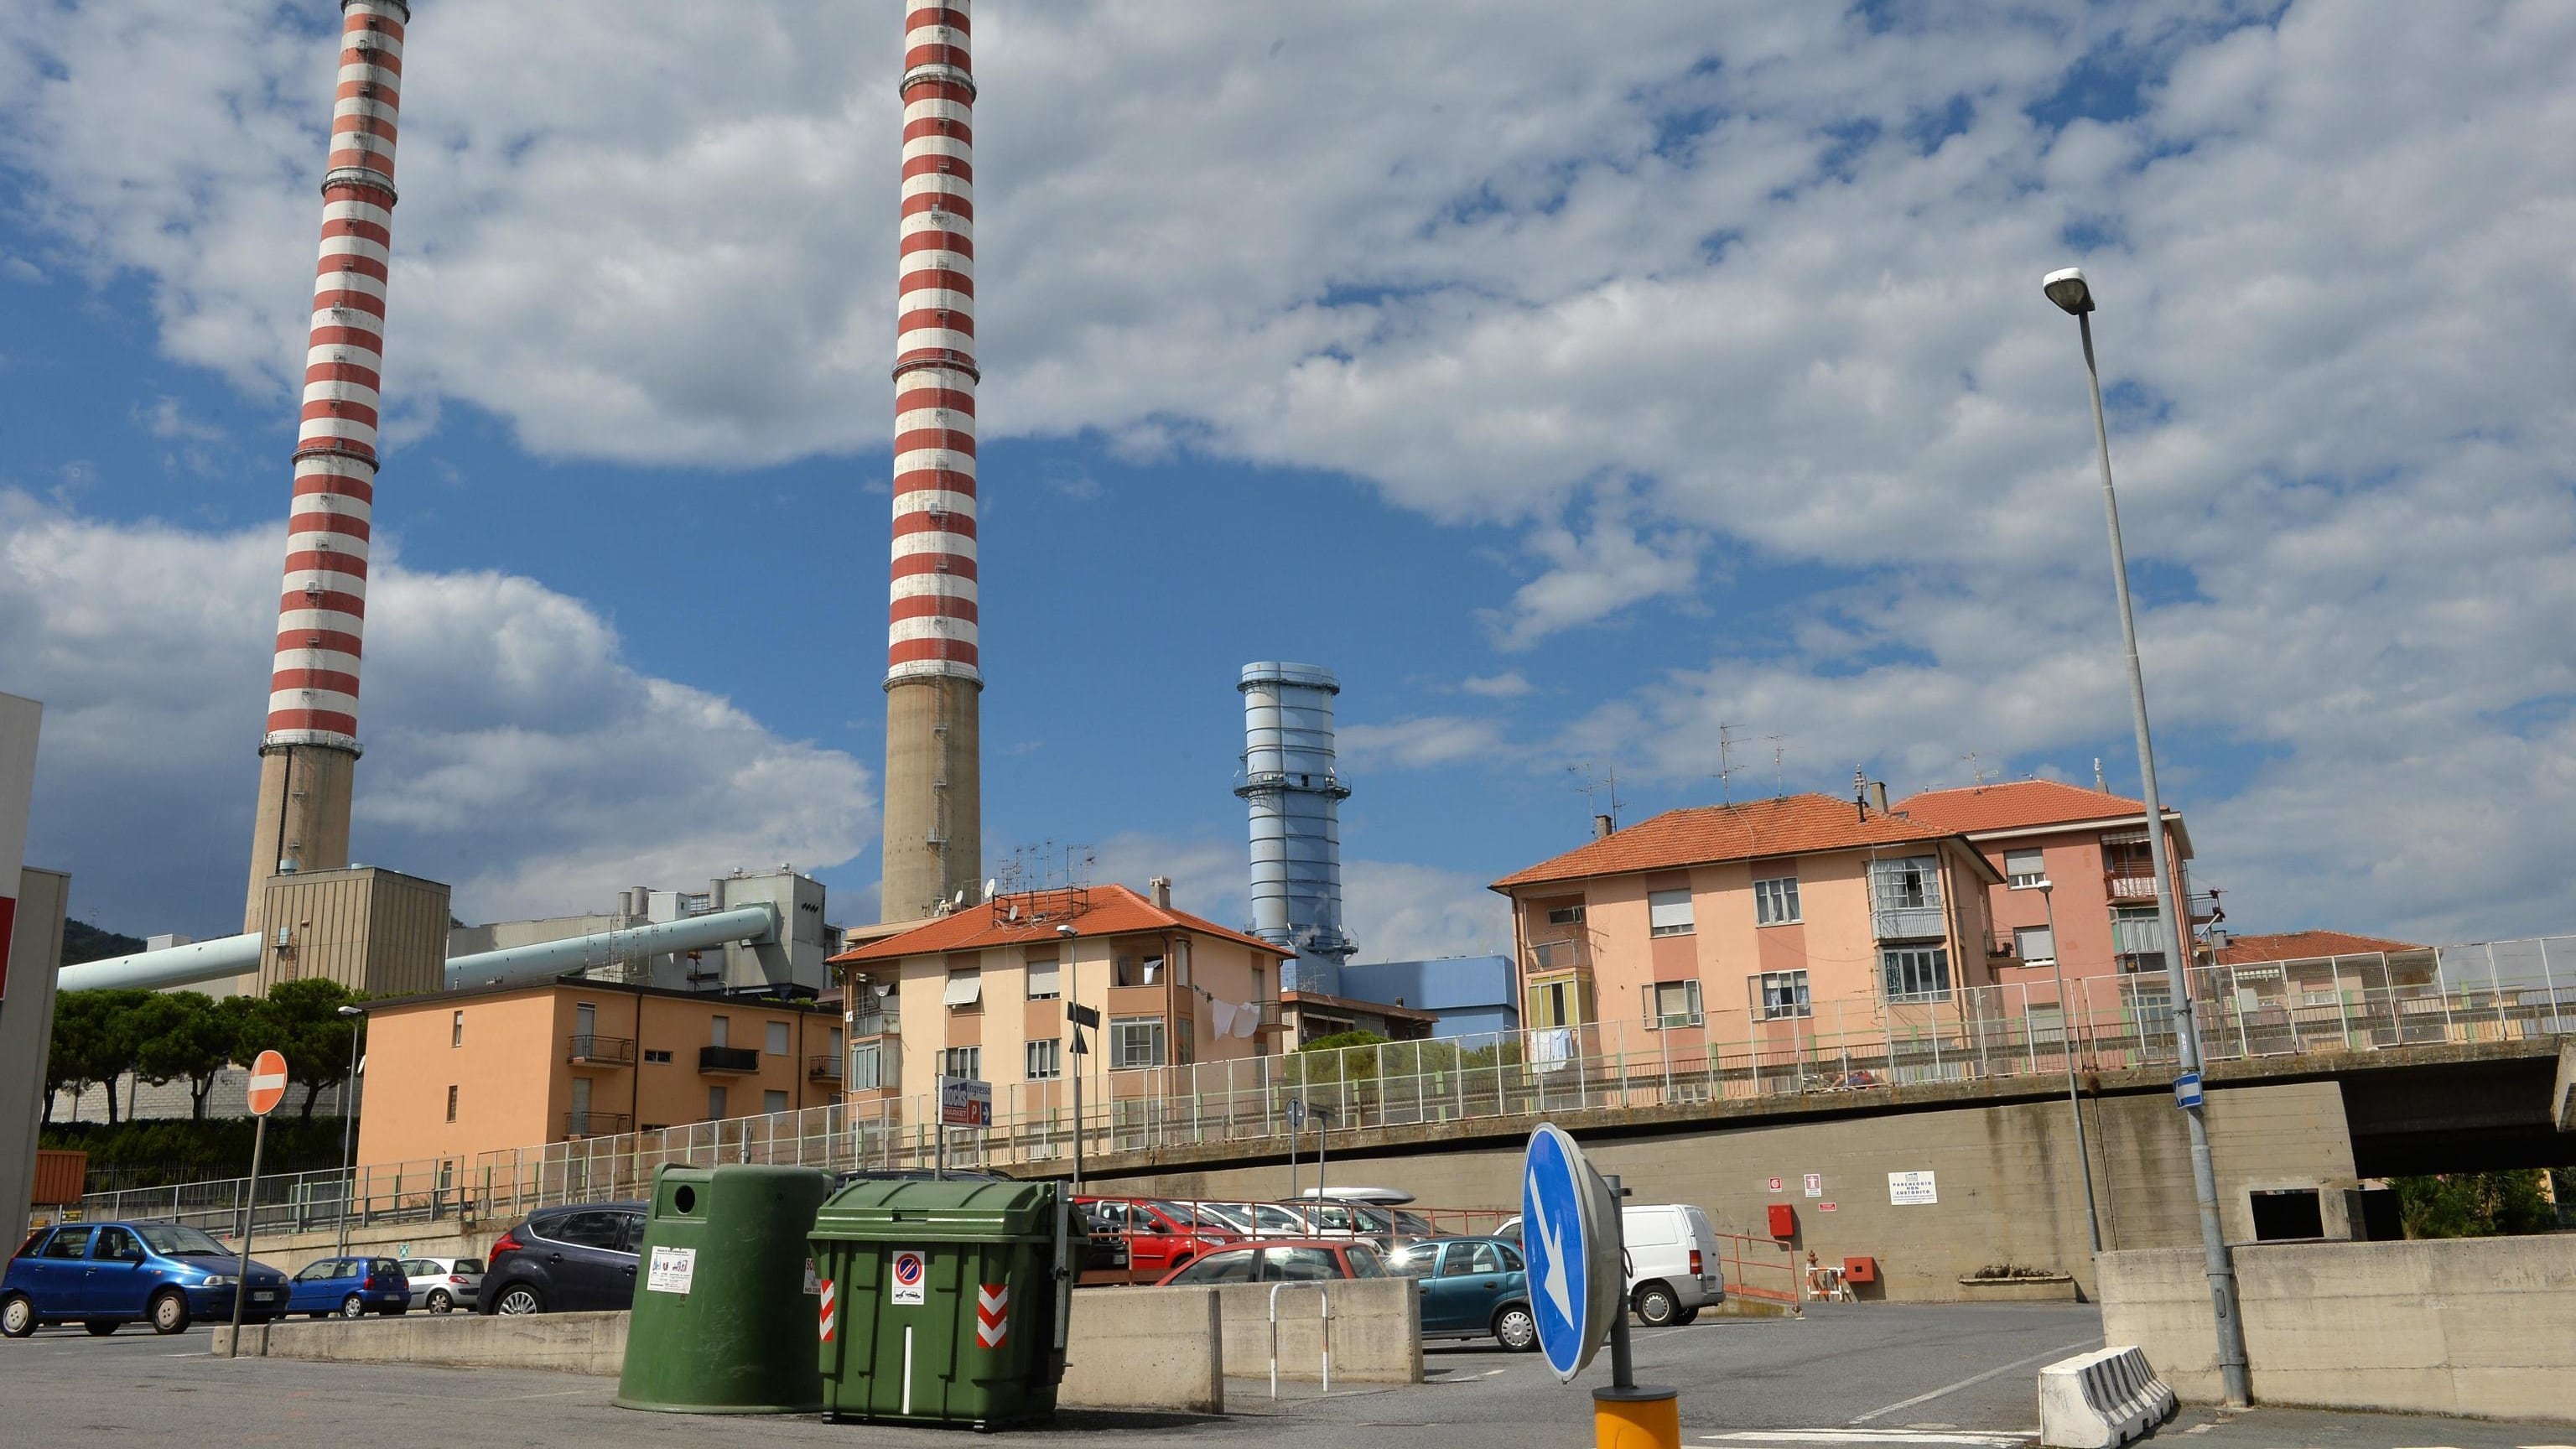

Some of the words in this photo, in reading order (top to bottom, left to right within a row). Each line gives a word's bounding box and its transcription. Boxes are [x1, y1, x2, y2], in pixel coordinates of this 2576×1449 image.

[943, 1083, 967, 1108] docks
[968, 1083, 990, 1096] Ingresso
[944, 1108, 966, 1117] MARKET
[972, 1104, 977, 1119] P
